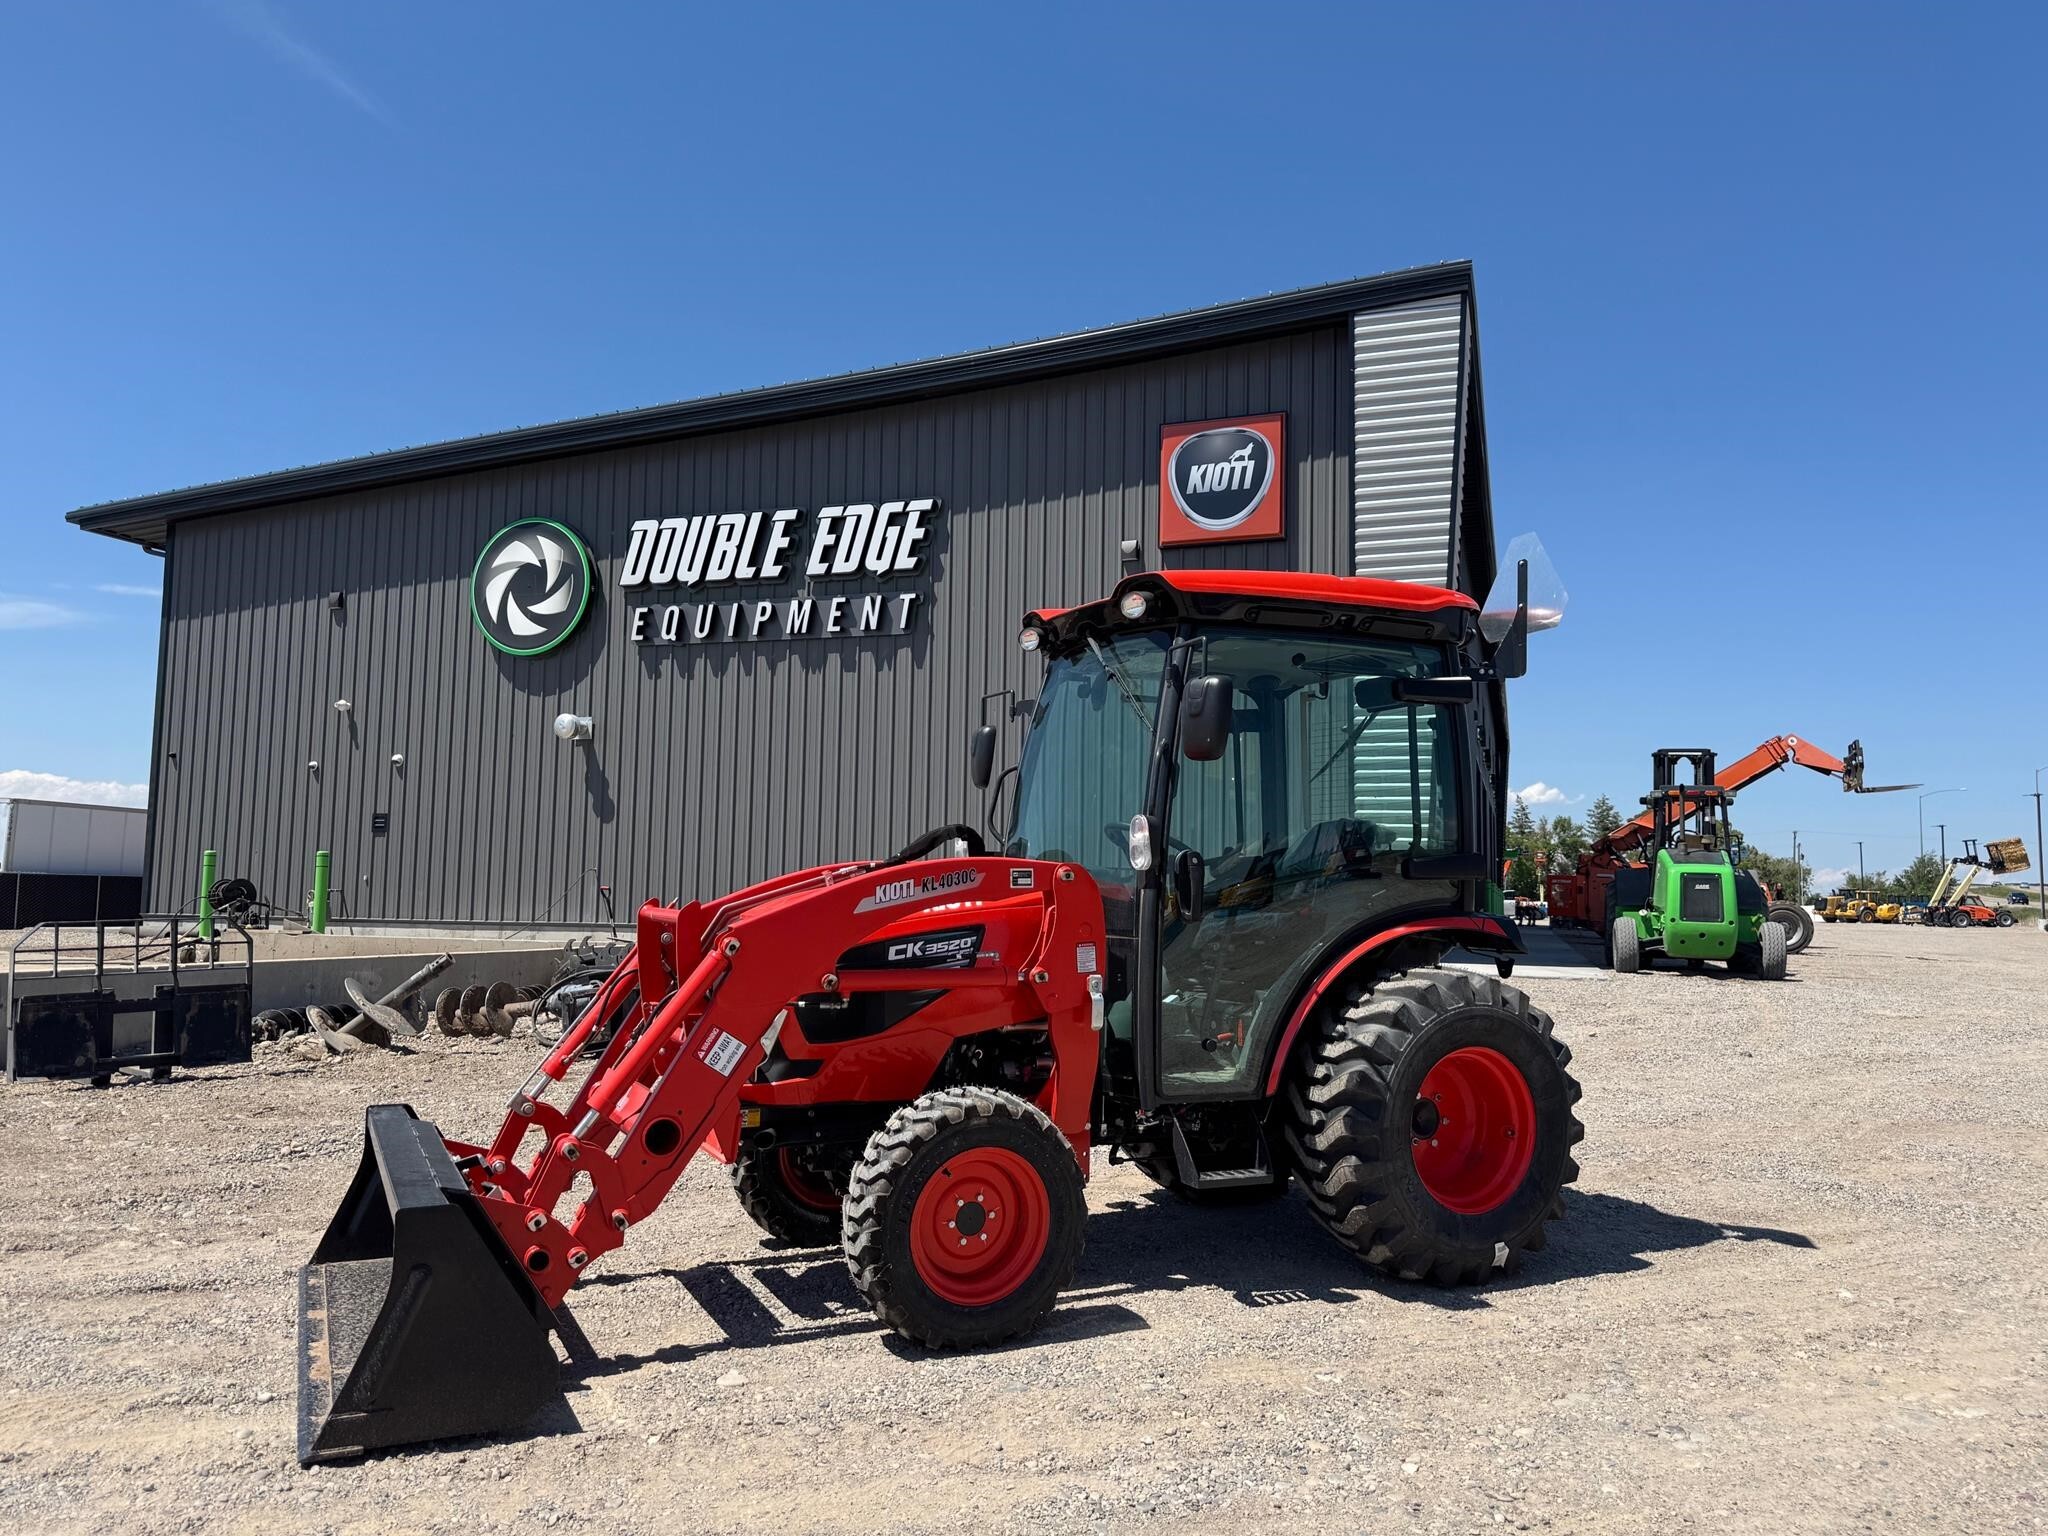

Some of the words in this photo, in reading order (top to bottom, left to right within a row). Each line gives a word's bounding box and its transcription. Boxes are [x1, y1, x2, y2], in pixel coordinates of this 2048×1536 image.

[1186, 460, 1255, 494] KIOTI
[619, 508, 799, 587] DOUBLE
[805, 498, 938, 576] EDGE
[631, 593, 917, 642] EQUIPMENT
[875, 879, 914, 904] KIOTI
[921, 867, 976, 893] KL4030C
[701, 1027, 719, 1051] WARNING
[708, 1051, 721, 1067] KEEP
[718, 1035, 733, 1053] AWAY
